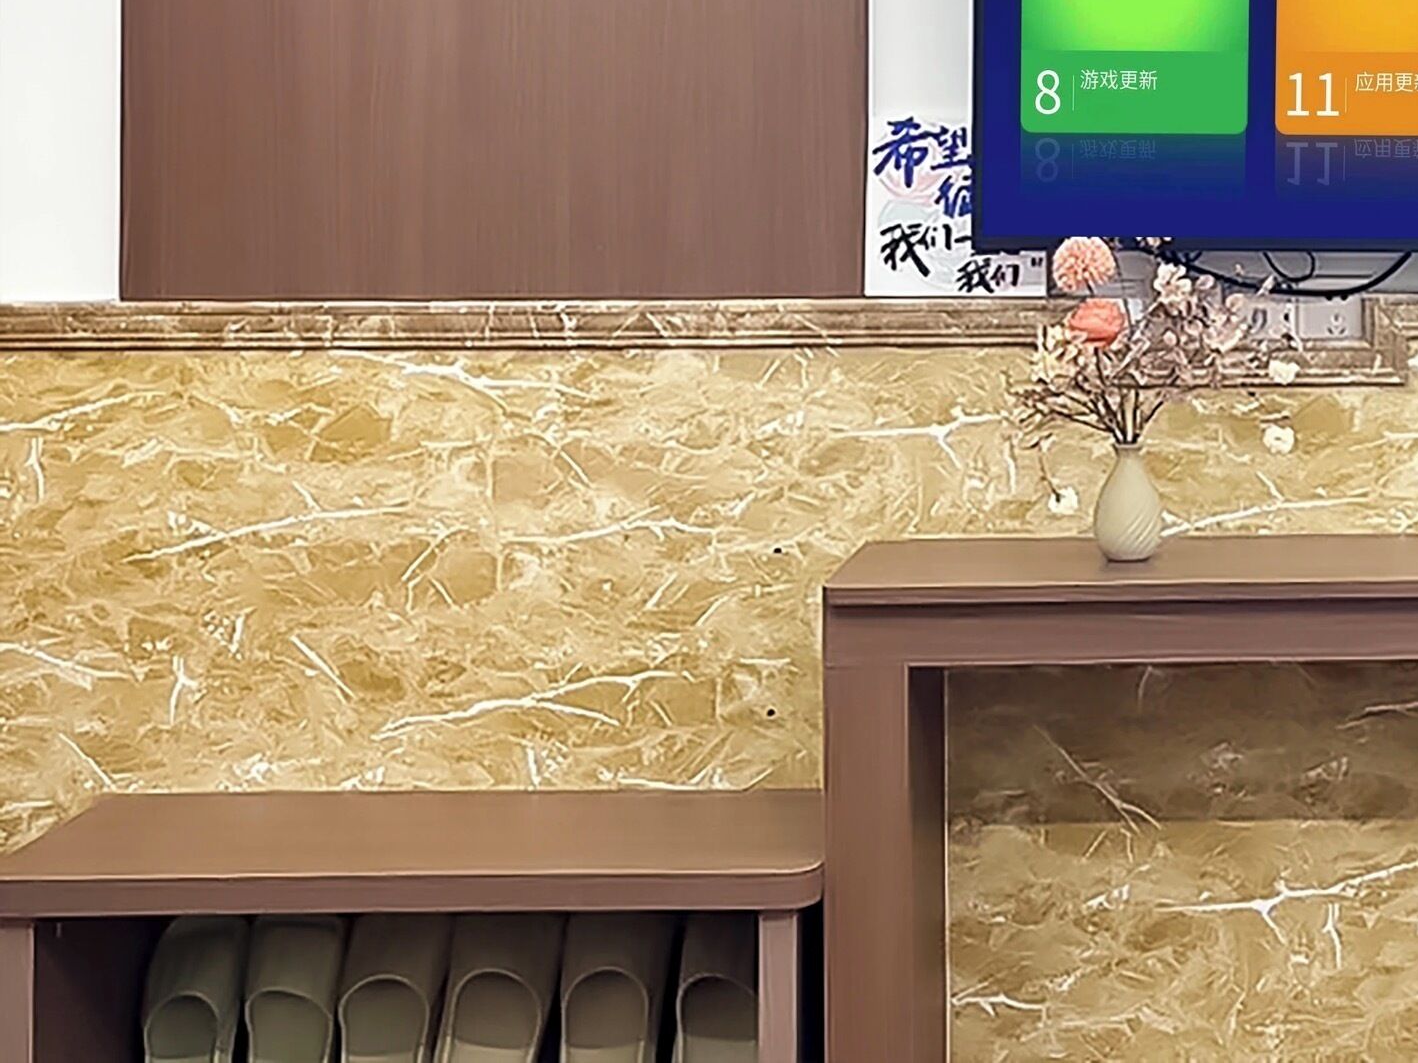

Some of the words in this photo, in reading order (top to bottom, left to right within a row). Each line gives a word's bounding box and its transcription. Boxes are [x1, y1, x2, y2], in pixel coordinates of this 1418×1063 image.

[1033, 69, 1062, 115] 8
[1079, 69, 1159, 91] 游戏更新
[1286, 72, 1340, 117] 11
[871, 115, 973, 189] 希望
